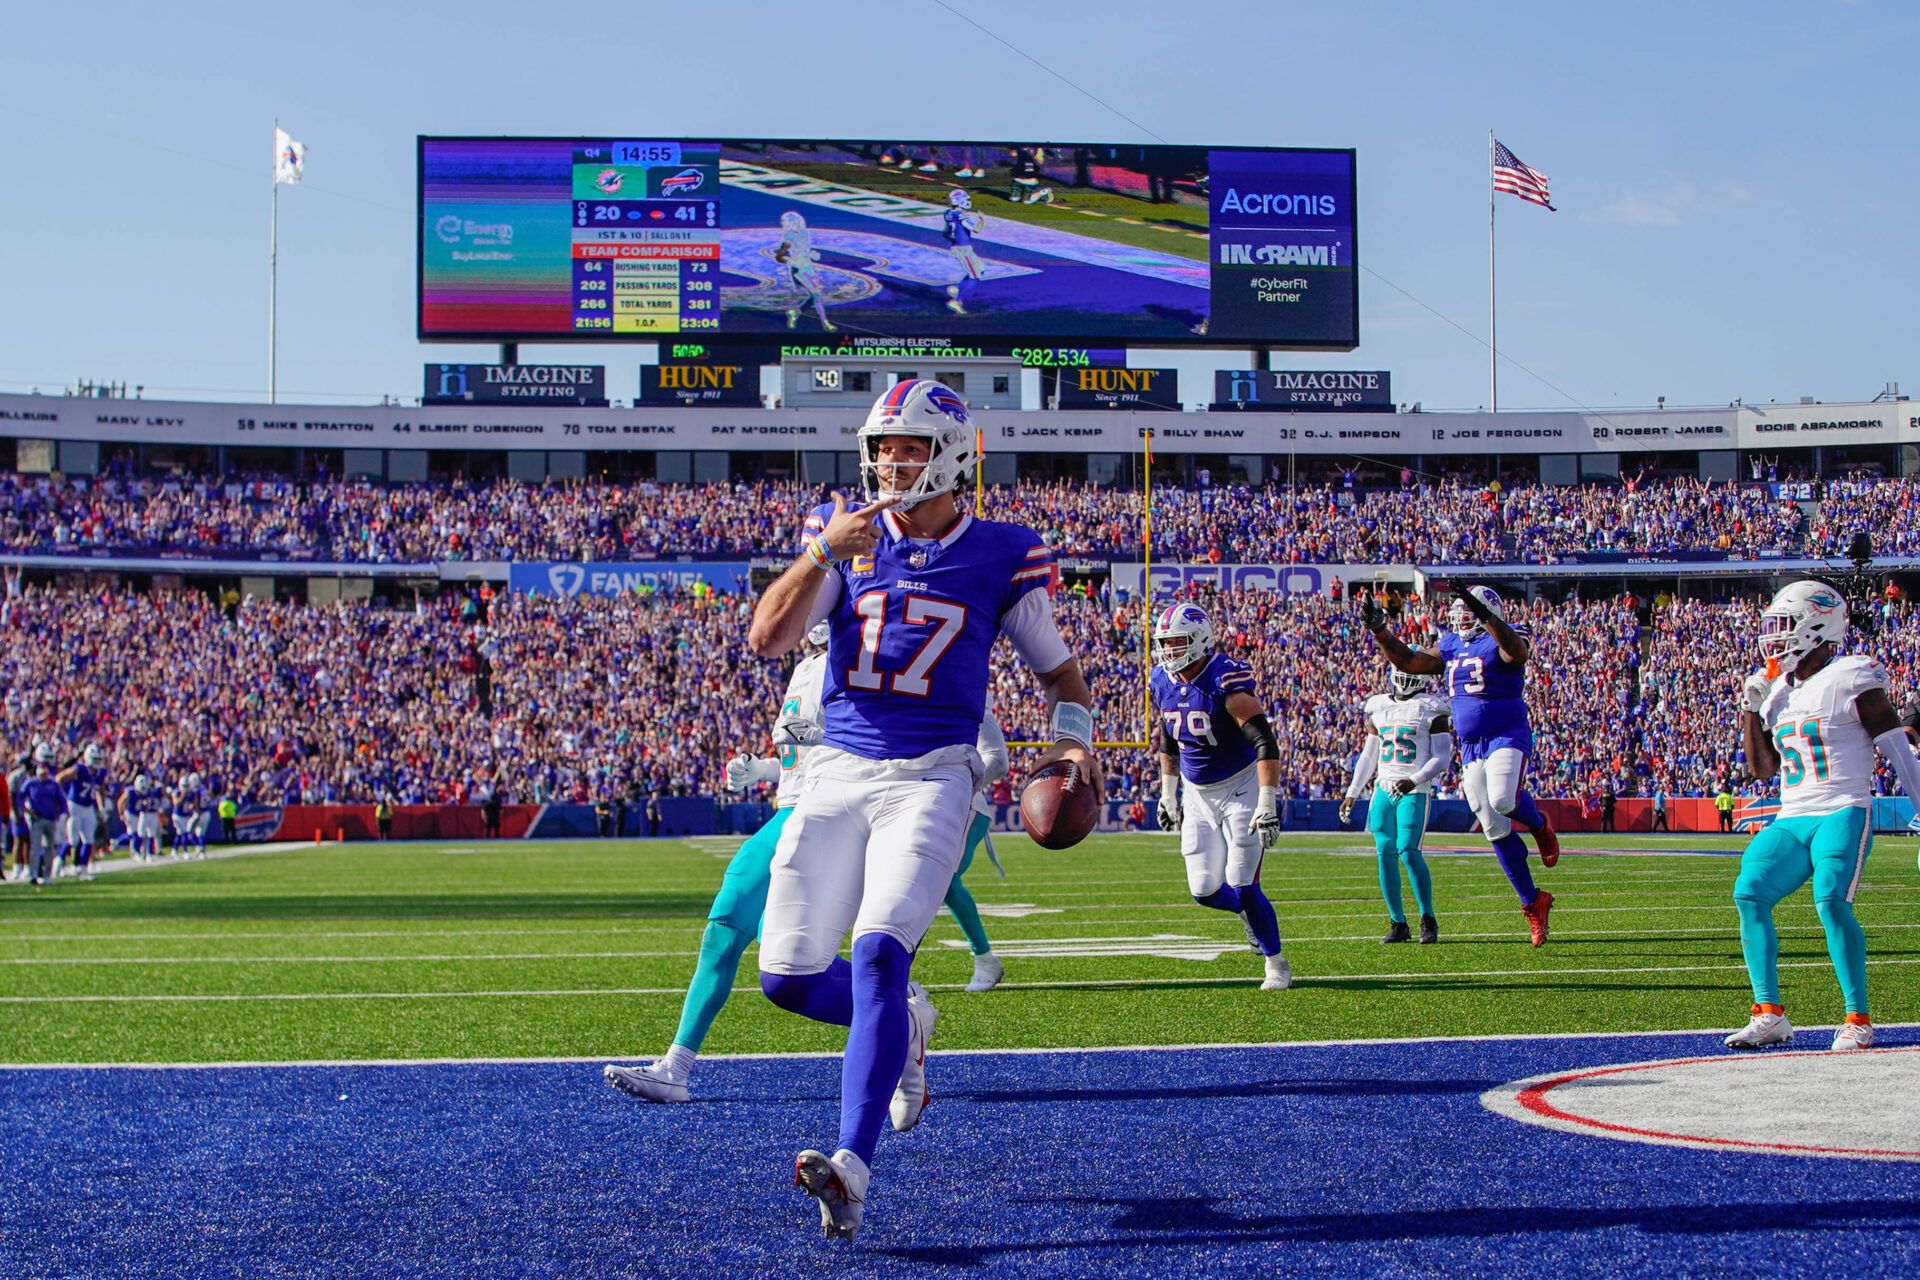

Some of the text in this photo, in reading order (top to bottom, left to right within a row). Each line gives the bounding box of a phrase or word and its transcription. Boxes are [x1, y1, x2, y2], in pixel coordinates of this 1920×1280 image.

[621, 147, 672, 161] 14:55
[1220, 188, 1336, 215] Acronis
[594, 206, 621, 220] 20
[674, 206, 696, 221] 41
[598, 231, 616, 240] 1ST
[630, 231, 642, 240] 10
[682, 231, 691, 240] 11
[580, 246, 713, 257] TEAM COMPARISON
[1220, 244, 1328, 266] INGRAM
[584, 262, 708, 272] 64 RUSHING YARDS 73
[580, 280, 713, 291] 202 PASSING YARDS 308
[1250, 278, 1308, 291] #CyberFit
[1257, 291, 1301, 302] Partner
[580, 299, 711, 309] 266 TOTAL YARDS 381
[575, 317, 719, 328] 21:56 T.O.P. 23:04
[854, 338, 952, 347] MITSUBISHI ELECTRIC
[484, 366, 593, 384] IMAGINE
[659, 365, 738, 388] HUNT
[815, 369, 839, 388] 40
[1078, 369, 1156, 391] HUNT
[1274, 373, 1379, 389] IMAGINE
[501, 386, 576, 396] STAFFING
[676, 390, 721, 399] Since 1911
[1095, 393, 1139, 401] Since 1911
[1291, 393, 1362, 402] STAFFING
[97, 415, 185, 427] MARV LEVY
[238, 419, 374, 431] 58 MIKE STRATTON
[1756, 420, 1882, 432] EDDIE ABRAMOSKI
[1910, 417, 1920, 428] 2
[393, 423, 544, 434] 44 ELBERT DUBENION
[563, 424, 580, 435] 70
[623, 425, 675, 433] SESTAK
[711, 426, 735, 434] PAT
[1002, 426, 1103, 437] 15 JACK KEMP
[1163, 429, 1198, 437] BILLY
[1280, 429, 1400, 439] 32 O.J. SIMPSON
[1432, 429, 1562, 439] 12 JOE FERGUSON
[1593, 426, 1723, 438] 20 ROBERT JAMES
[897, 579, 928, 591] BILLS
[1139, 566, 1321, 600] GEICO
[846, 591, 968, 699] 17
[1163, 710, 1218, 749] 79
[1379, 725, 1419, 766] 55
[1776, 718, 1830, 789] 51
